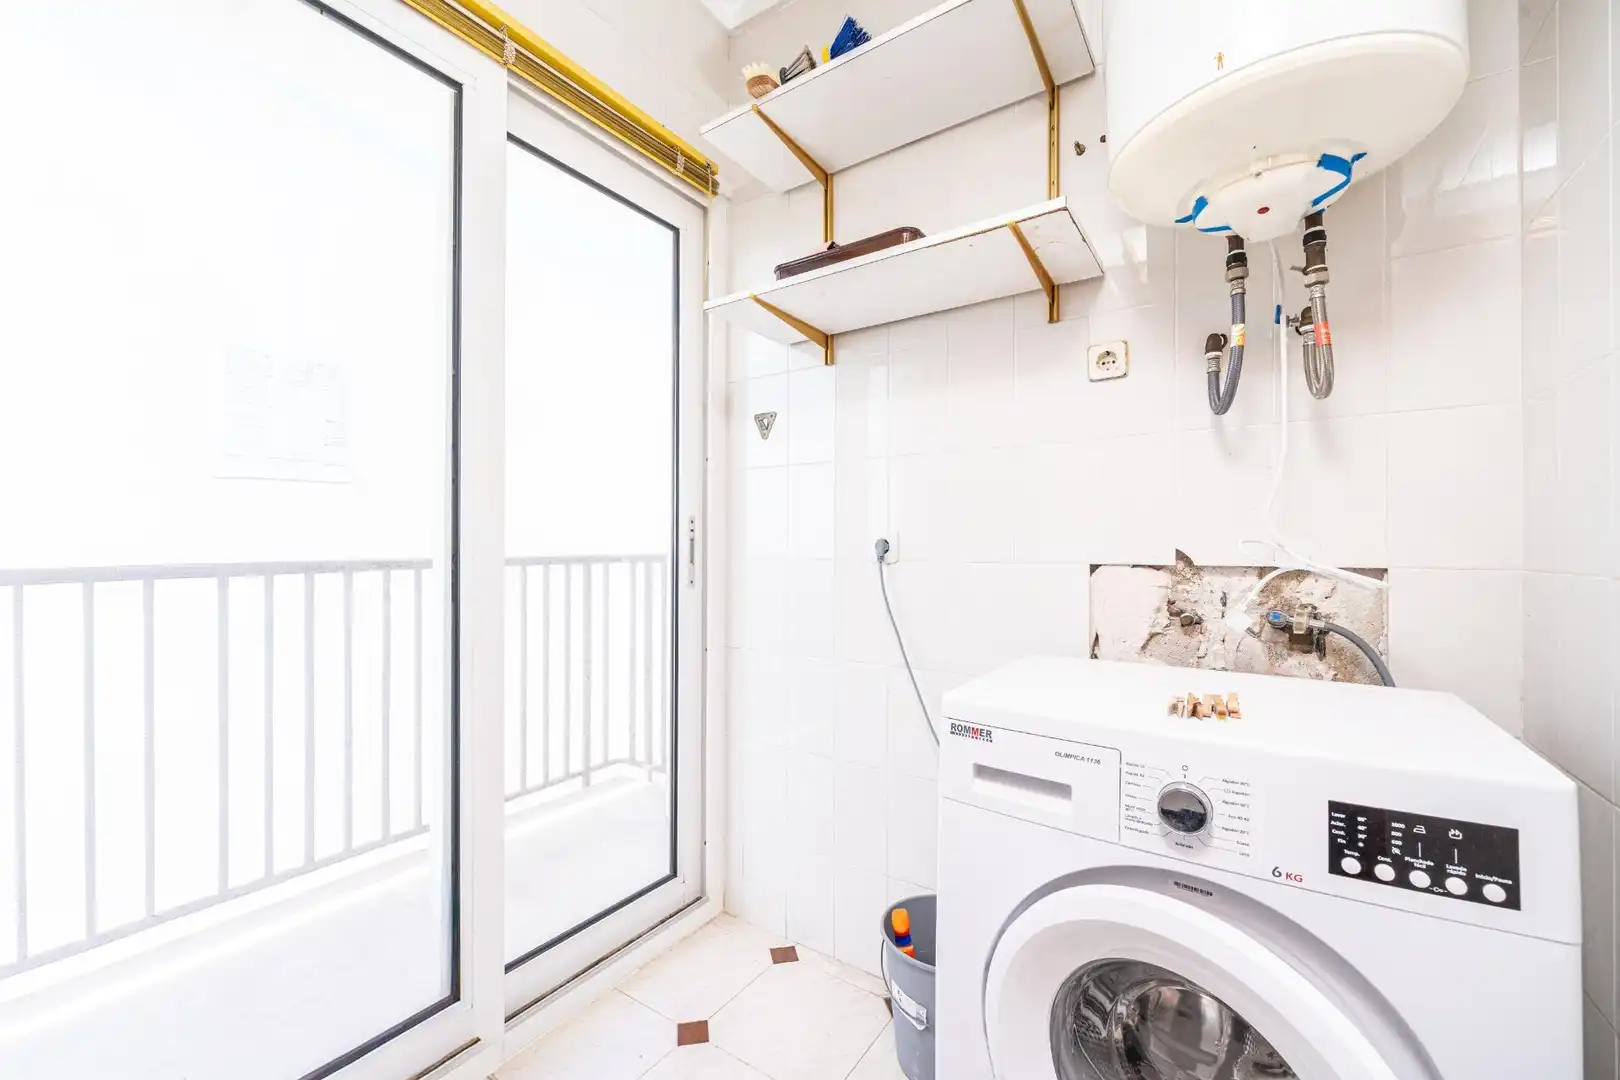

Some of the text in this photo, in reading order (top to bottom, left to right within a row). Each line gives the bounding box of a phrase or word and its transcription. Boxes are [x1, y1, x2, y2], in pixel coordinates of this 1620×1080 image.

[950, 722, 992, 738] ROMMER
[1054, 751, 1085, 762] OLIMPICA
[1271, 866, 1303, 883] 6 KG
